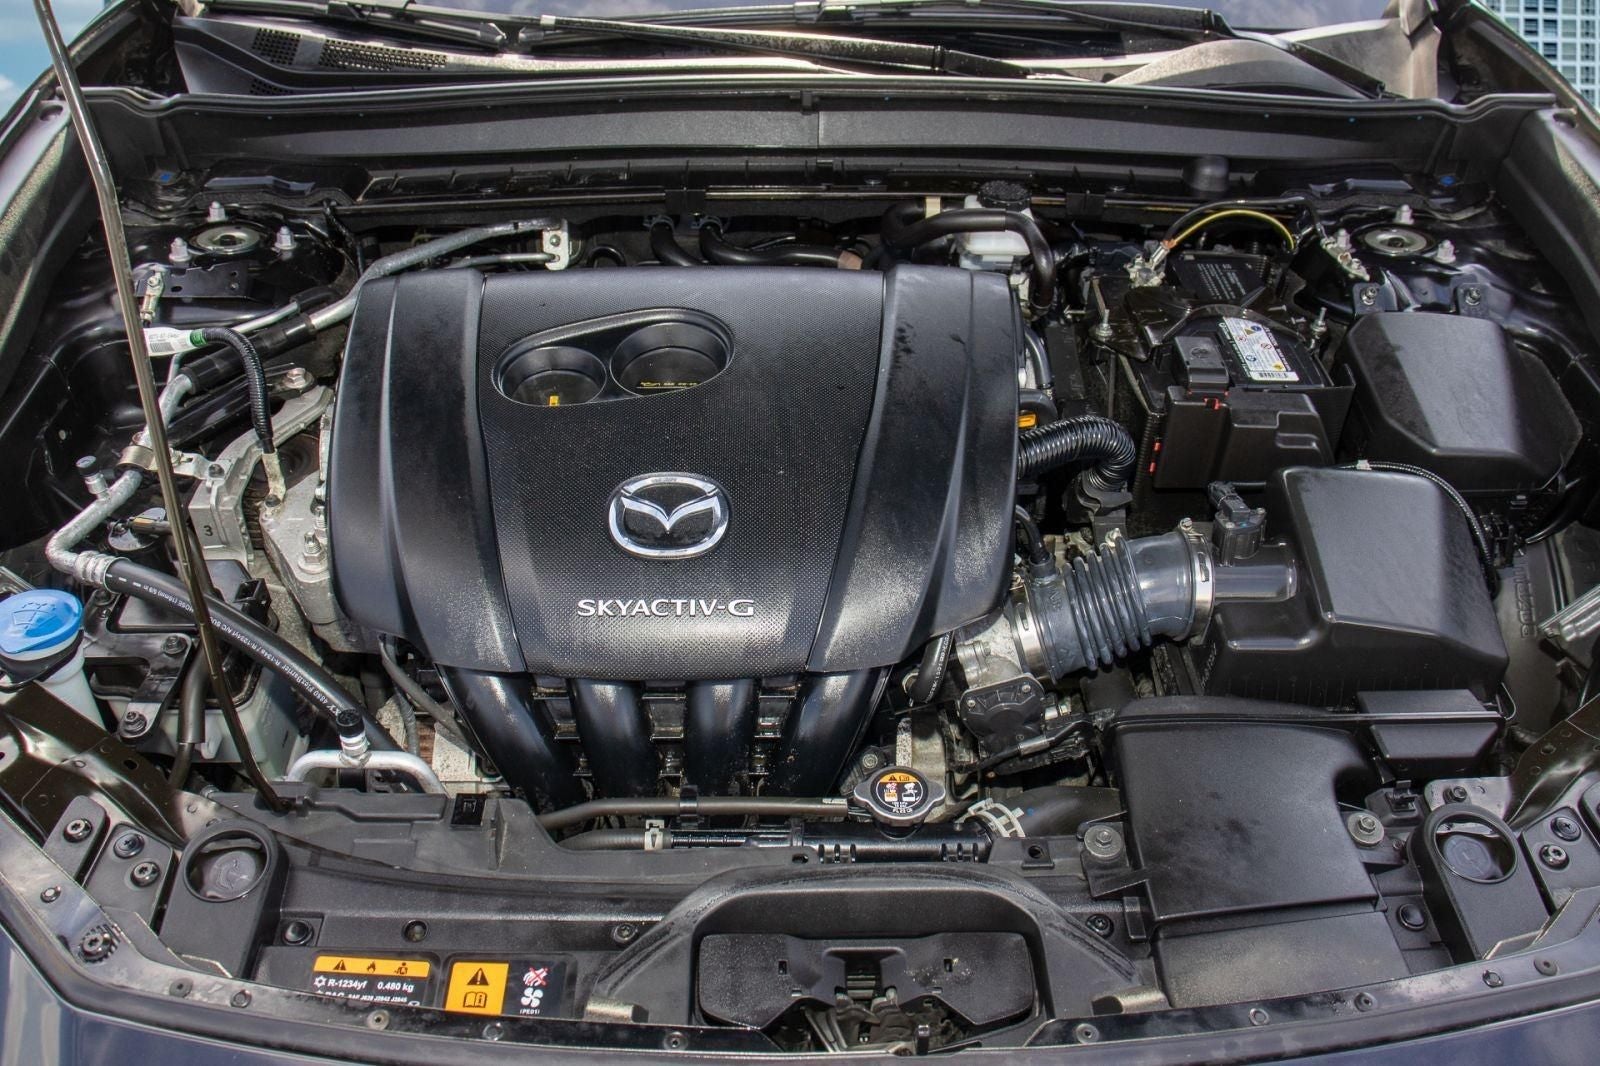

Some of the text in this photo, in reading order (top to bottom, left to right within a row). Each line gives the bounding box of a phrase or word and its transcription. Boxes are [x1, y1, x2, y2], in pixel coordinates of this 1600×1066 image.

[203, 524, 213, 536] 3
[577, 599, 755, 617] SKYACTIV-G
[327, 978, 414, 993] R-1234yf 0.480 kg
